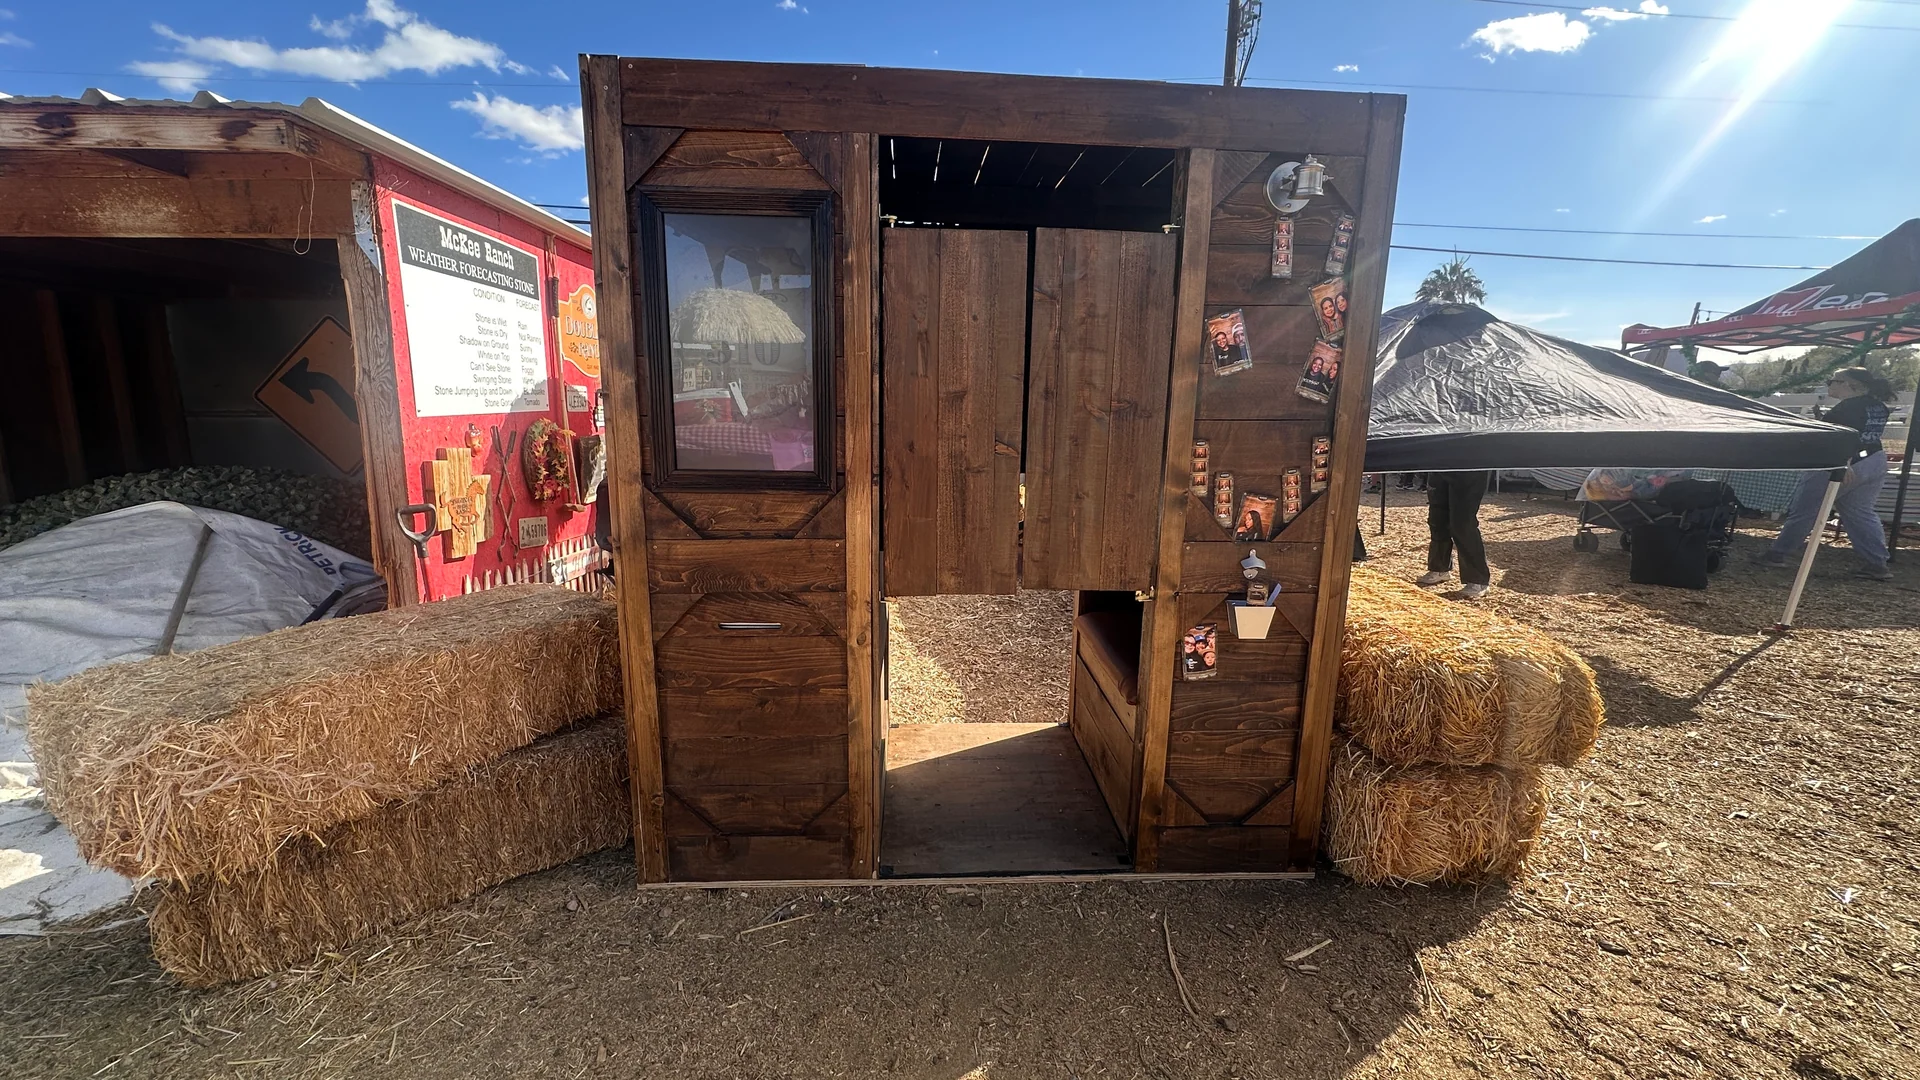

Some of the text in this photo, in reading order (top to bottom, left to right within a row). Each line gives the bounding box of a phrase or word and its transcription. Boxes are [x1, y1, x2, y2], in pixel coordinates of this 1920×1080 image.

[439, 225, 515, 270] McKee Ranch
[408, 245, 535, 295] WEATHER FORECASTING STONE
[473, 287, 506, 303] CONDITION
[516, 298, 540, 312] FORECAST
[475, 312, 491, 324] Stone
[477, 325, 493, 336] Stone
[499, 329, 508, 340] Dry
[459, 335, 510, 350] Shadow on Ground
[477, 350, 493, 360] White
[500, 351, 510, 362] Top
[470, 361, 511, 373] Can't See Stone
[521, 365, 535, 376] Foggy
[473, 373, 512, 385] Swinging Stone
[434, 385, 453, 396] Stone
[455, 386, 479, 397] Jumping
[479, 387, 487, 396] Up
[499, 386, 513, 395] Down
[484, 398, 500, 407] Stone
[523, 398, 541, 406] Tornado
[521, 525, 526, 541] 2
